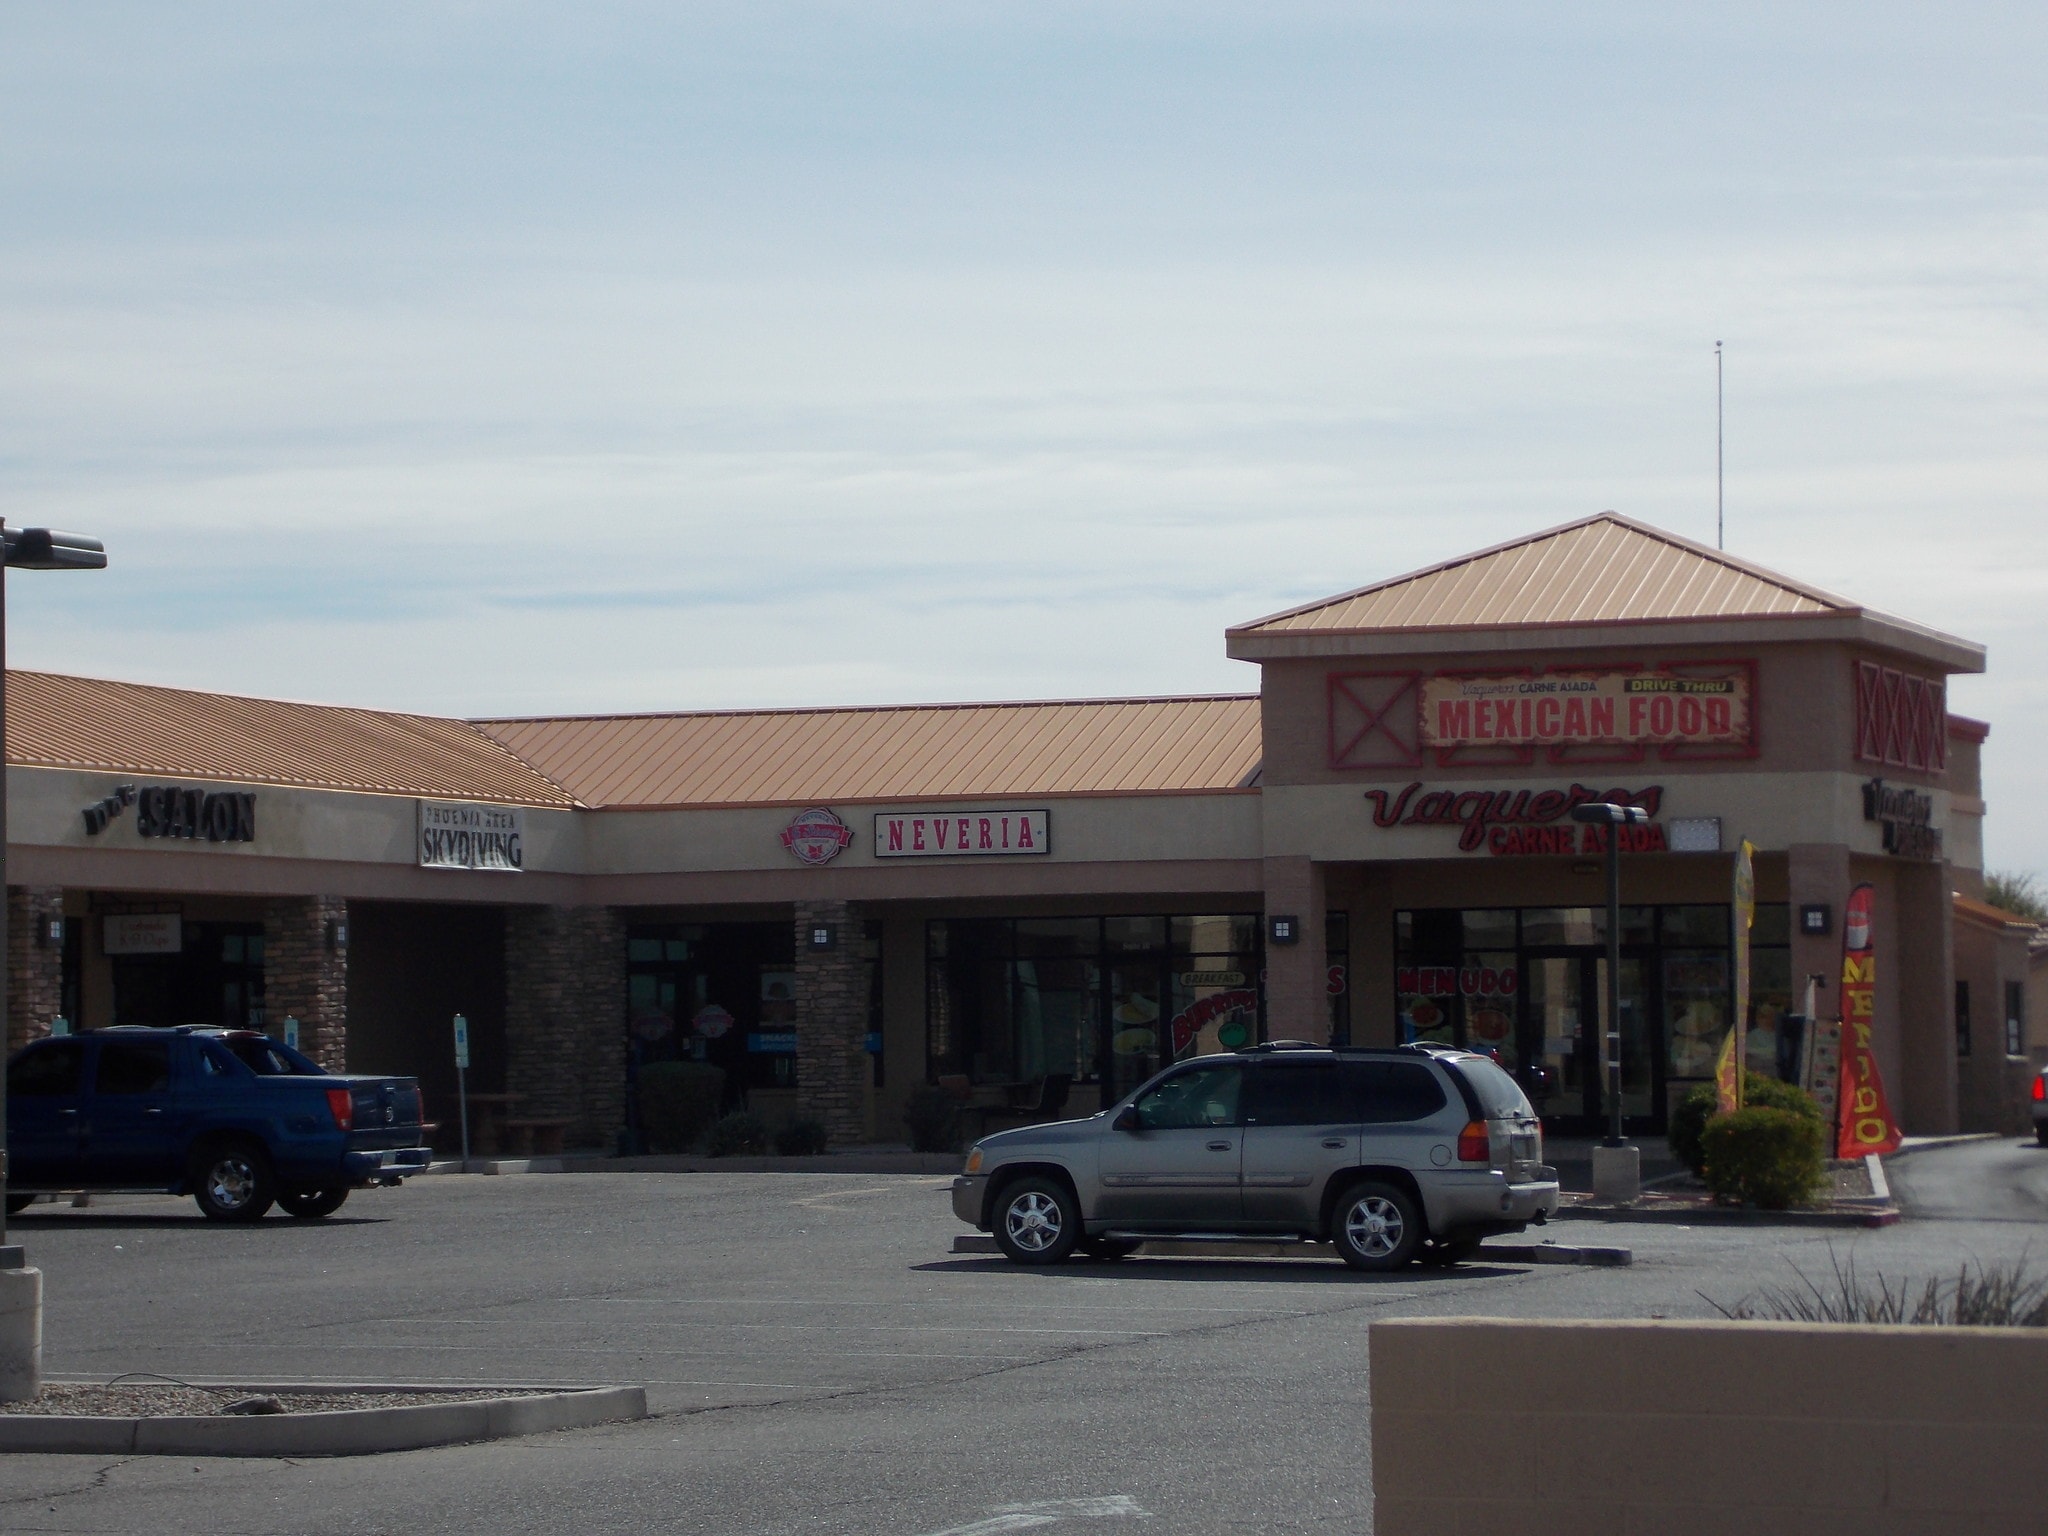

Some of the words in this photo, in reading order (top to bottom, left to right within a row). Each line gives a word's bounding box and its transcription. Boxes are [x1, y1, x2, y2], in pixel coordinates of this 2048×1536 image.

[1518, 682, 1557, 694] CARNE
[1560, 681, 1597, 692] ASADA
[1631, 680, 1678, 691] DRIVE
[1682, 681, 1727, 692] THRU
[1438, 697, 1614, 739] MEXICAN
[1628, 695, 1731, 736] FOOD
[423, 827, 522, 868] SKYDIVING
[888, 816, 1034, 851] NEVERIA
[1488, 825, 1575, 855] CARNE
